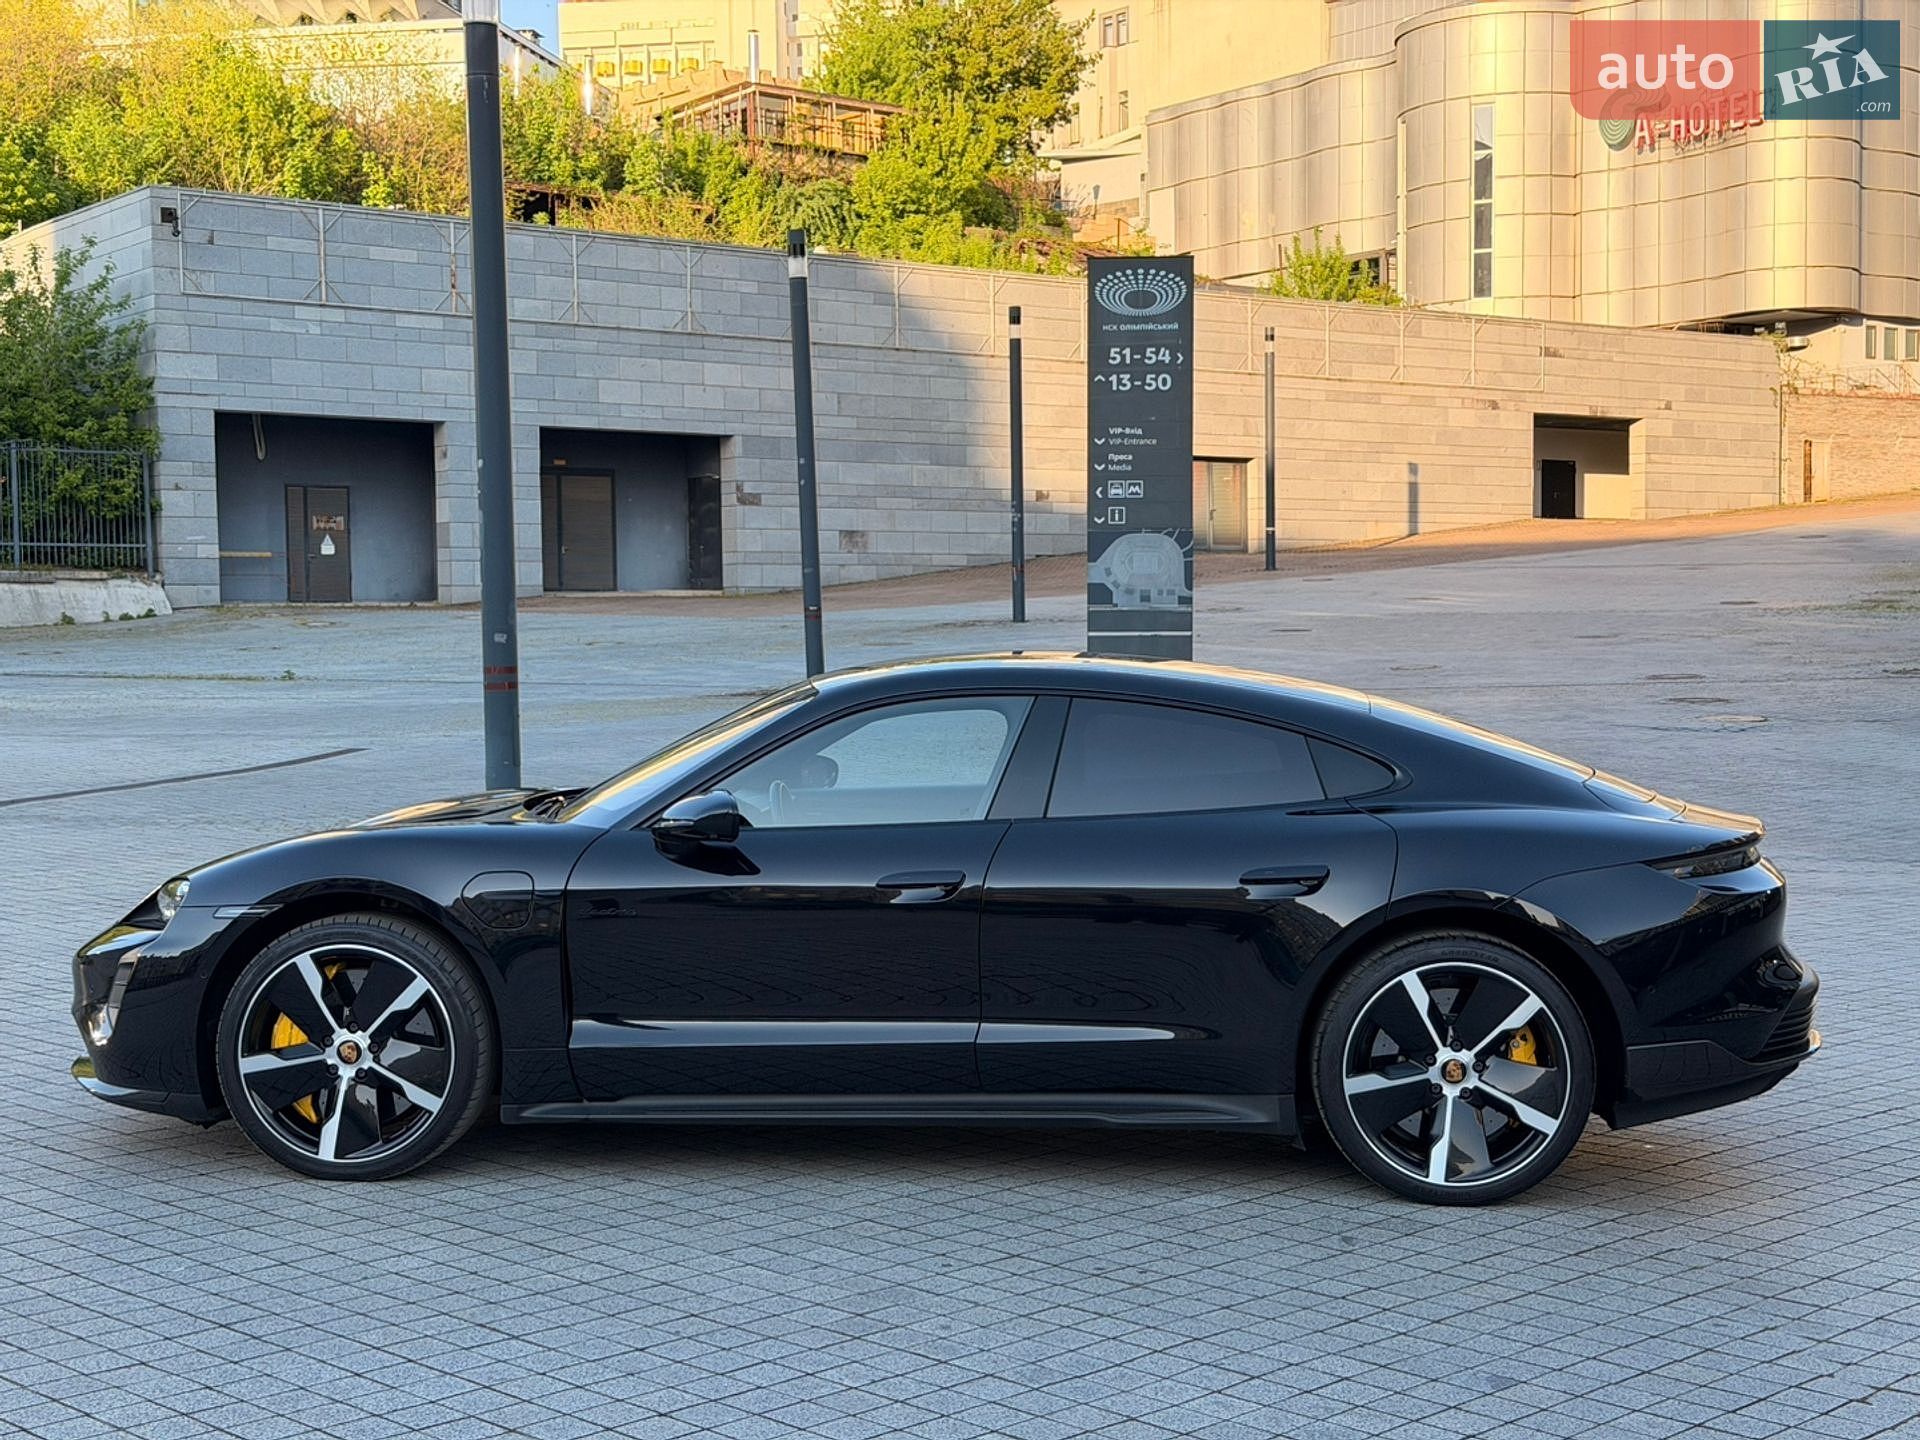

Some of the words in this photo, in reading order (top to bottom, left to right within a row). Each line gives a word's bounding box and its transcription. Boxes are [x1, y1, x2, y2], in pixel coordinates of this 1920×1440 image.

[1108, 347, 1171, 364] 51-54
[1108, 373, 1172, 391] 13-50
[1108, 437, 1157, 445] VIP-Entrance
[1108, 453, 1133, 462] Преса
[1108, 463, 1132, 471] Media
